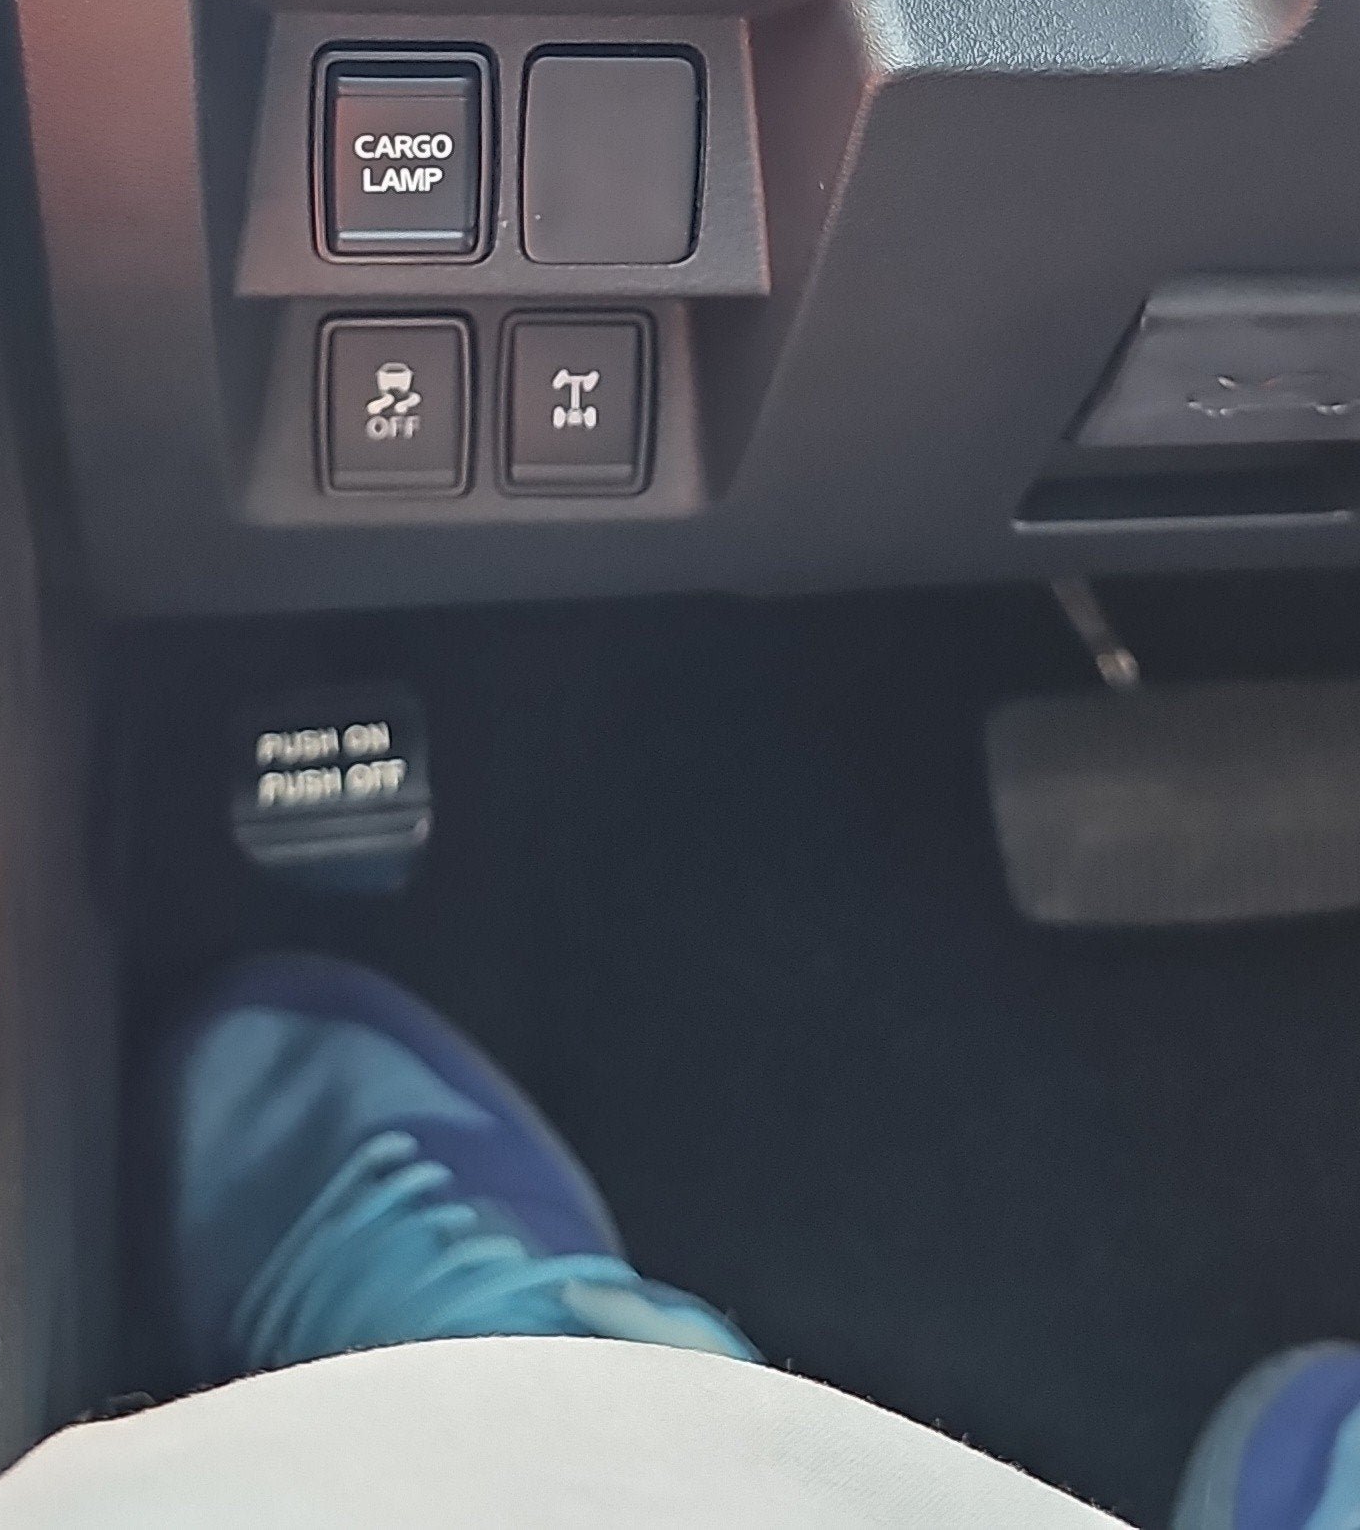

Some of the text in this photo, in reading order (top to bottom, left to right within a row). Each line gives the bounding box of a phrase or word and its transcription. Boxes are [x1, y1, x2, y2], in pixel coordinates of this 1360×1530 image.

[354, 134, 453, 159] CARGO
[362, 167, 443, 192] LAMP
[366, 416, 420, 440] OFF
[256, 721, 390, 766] PUSH ON
[257, 758, 408, 808] PUSH OFF
